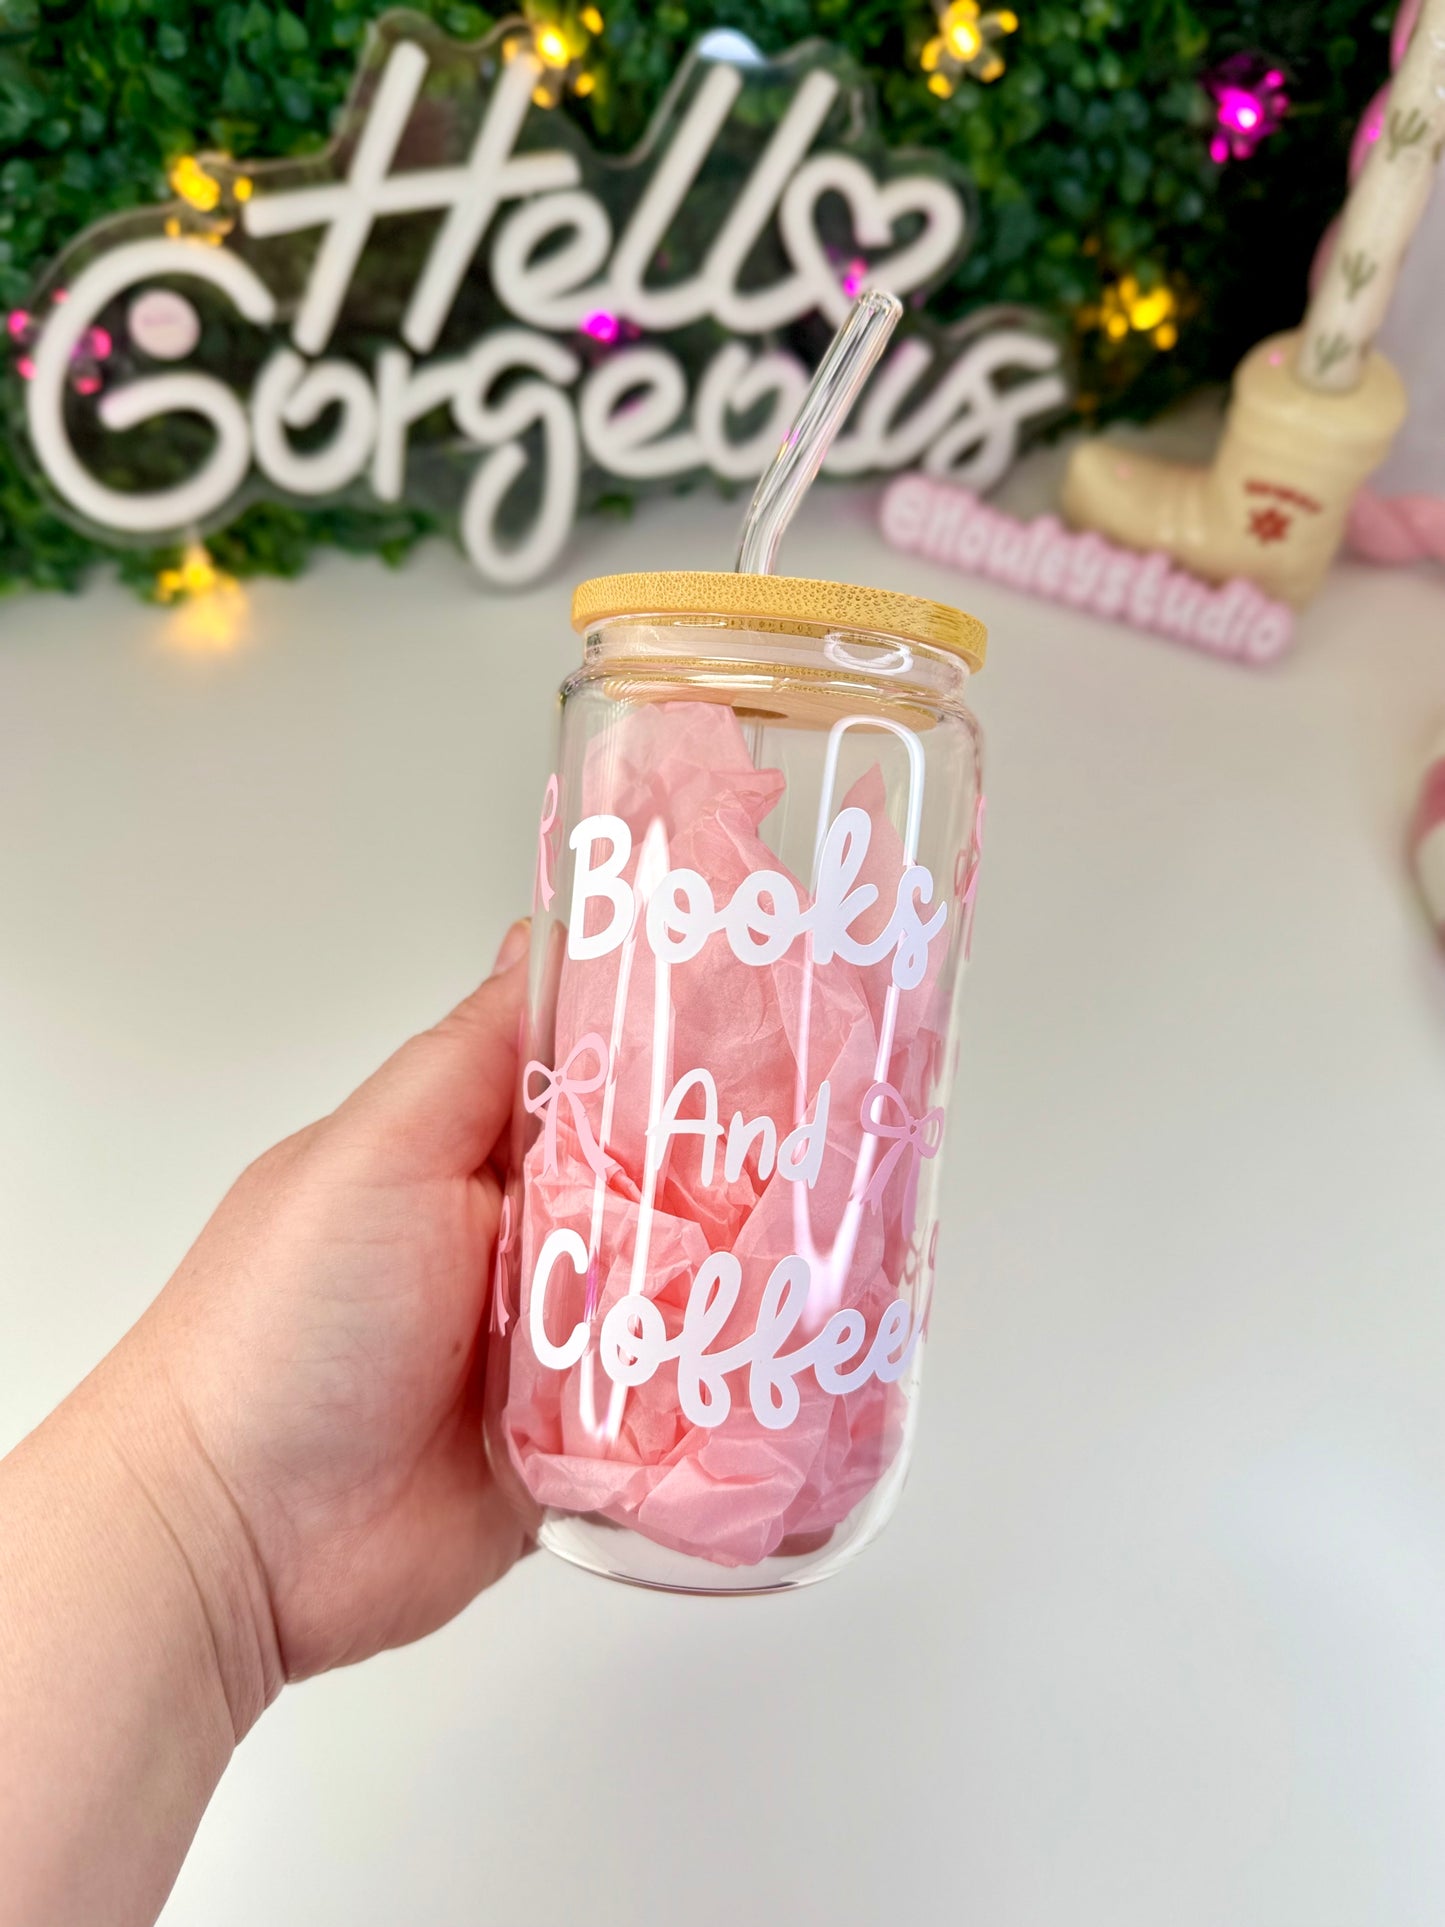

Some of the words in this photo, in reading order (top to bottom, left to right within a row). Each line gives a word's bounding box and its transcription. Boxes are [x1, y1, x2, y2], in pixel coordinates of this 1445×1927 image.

[28, 237, 1066, 584] Gorgeous
[568, 807, 946, 990] Books
[646, 1068, 830, 1189] And
[530, 1228, 922, 1429] Coffee
